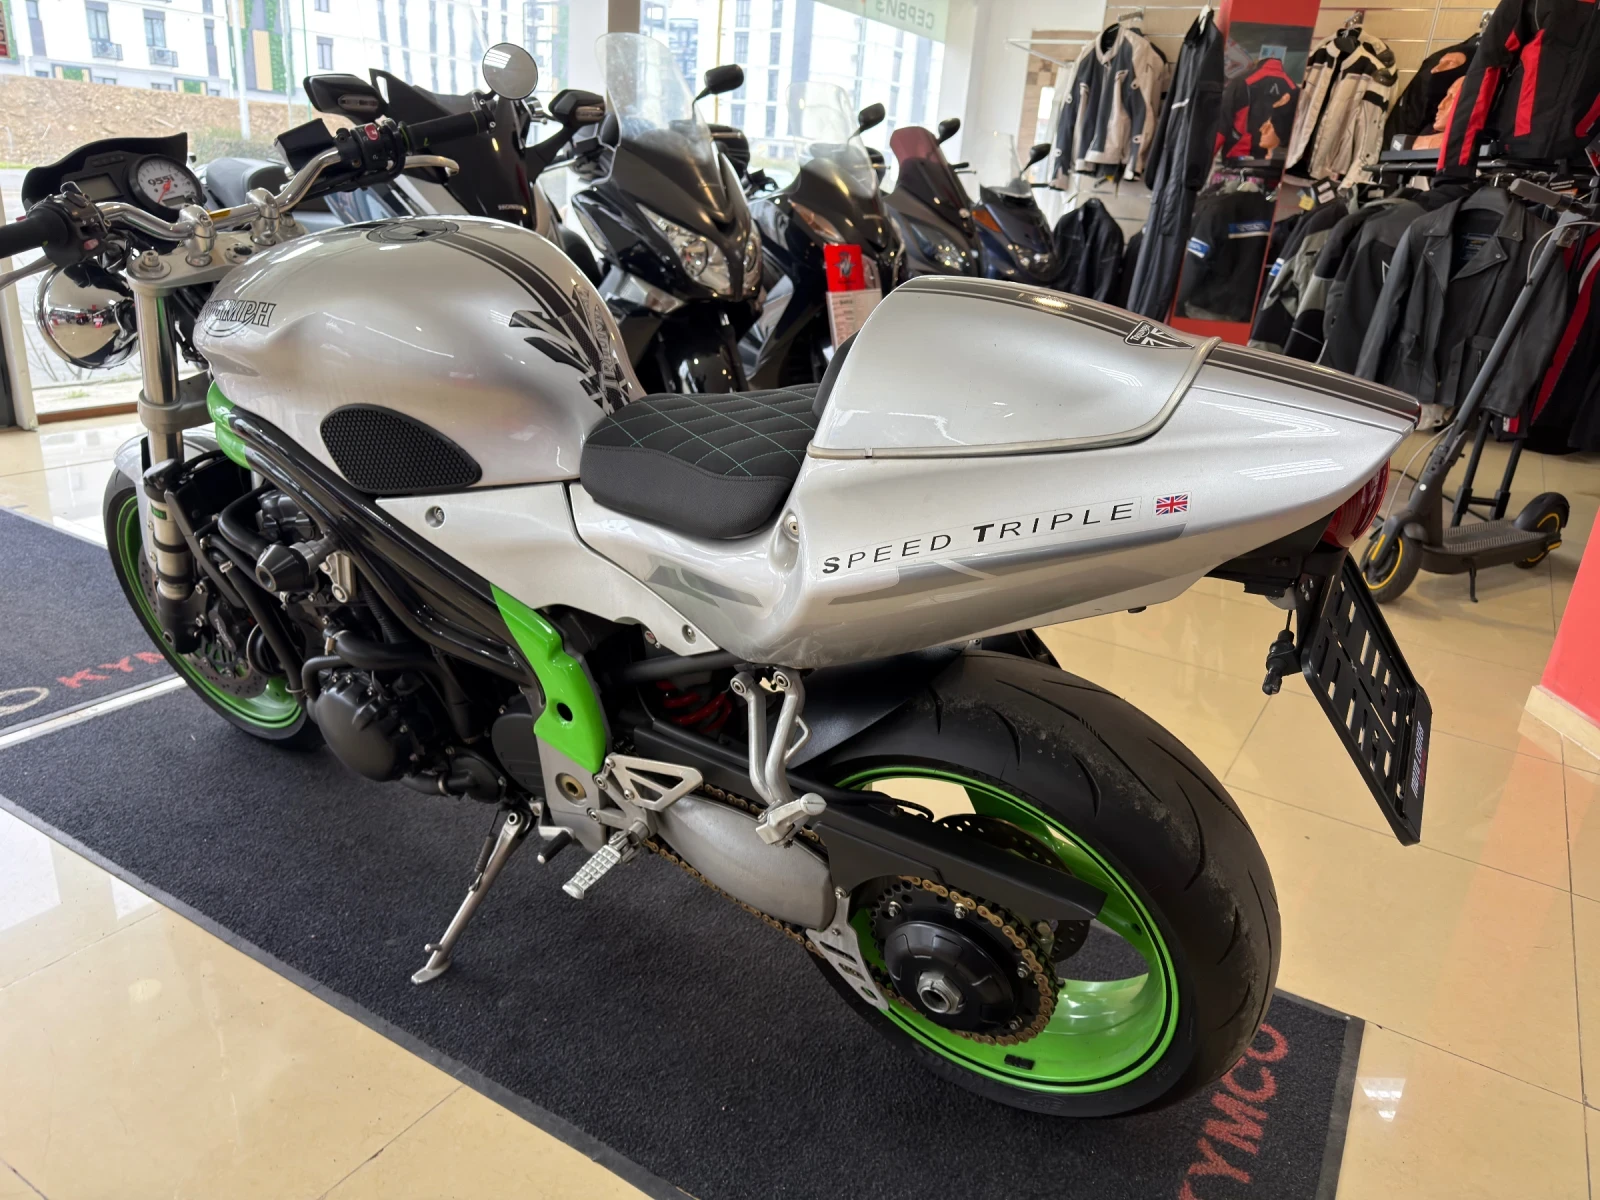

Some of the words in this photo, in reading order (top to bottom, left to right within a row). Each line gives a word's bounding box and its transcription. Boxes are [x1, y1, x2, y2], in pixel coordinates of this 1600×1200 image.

[148, 174, 175, 187] 955i
[821, 534, 952, 575] SPEED
[972, 502, 1135, 543] TRIPLE
[56, 651, 166, 689] KYM
